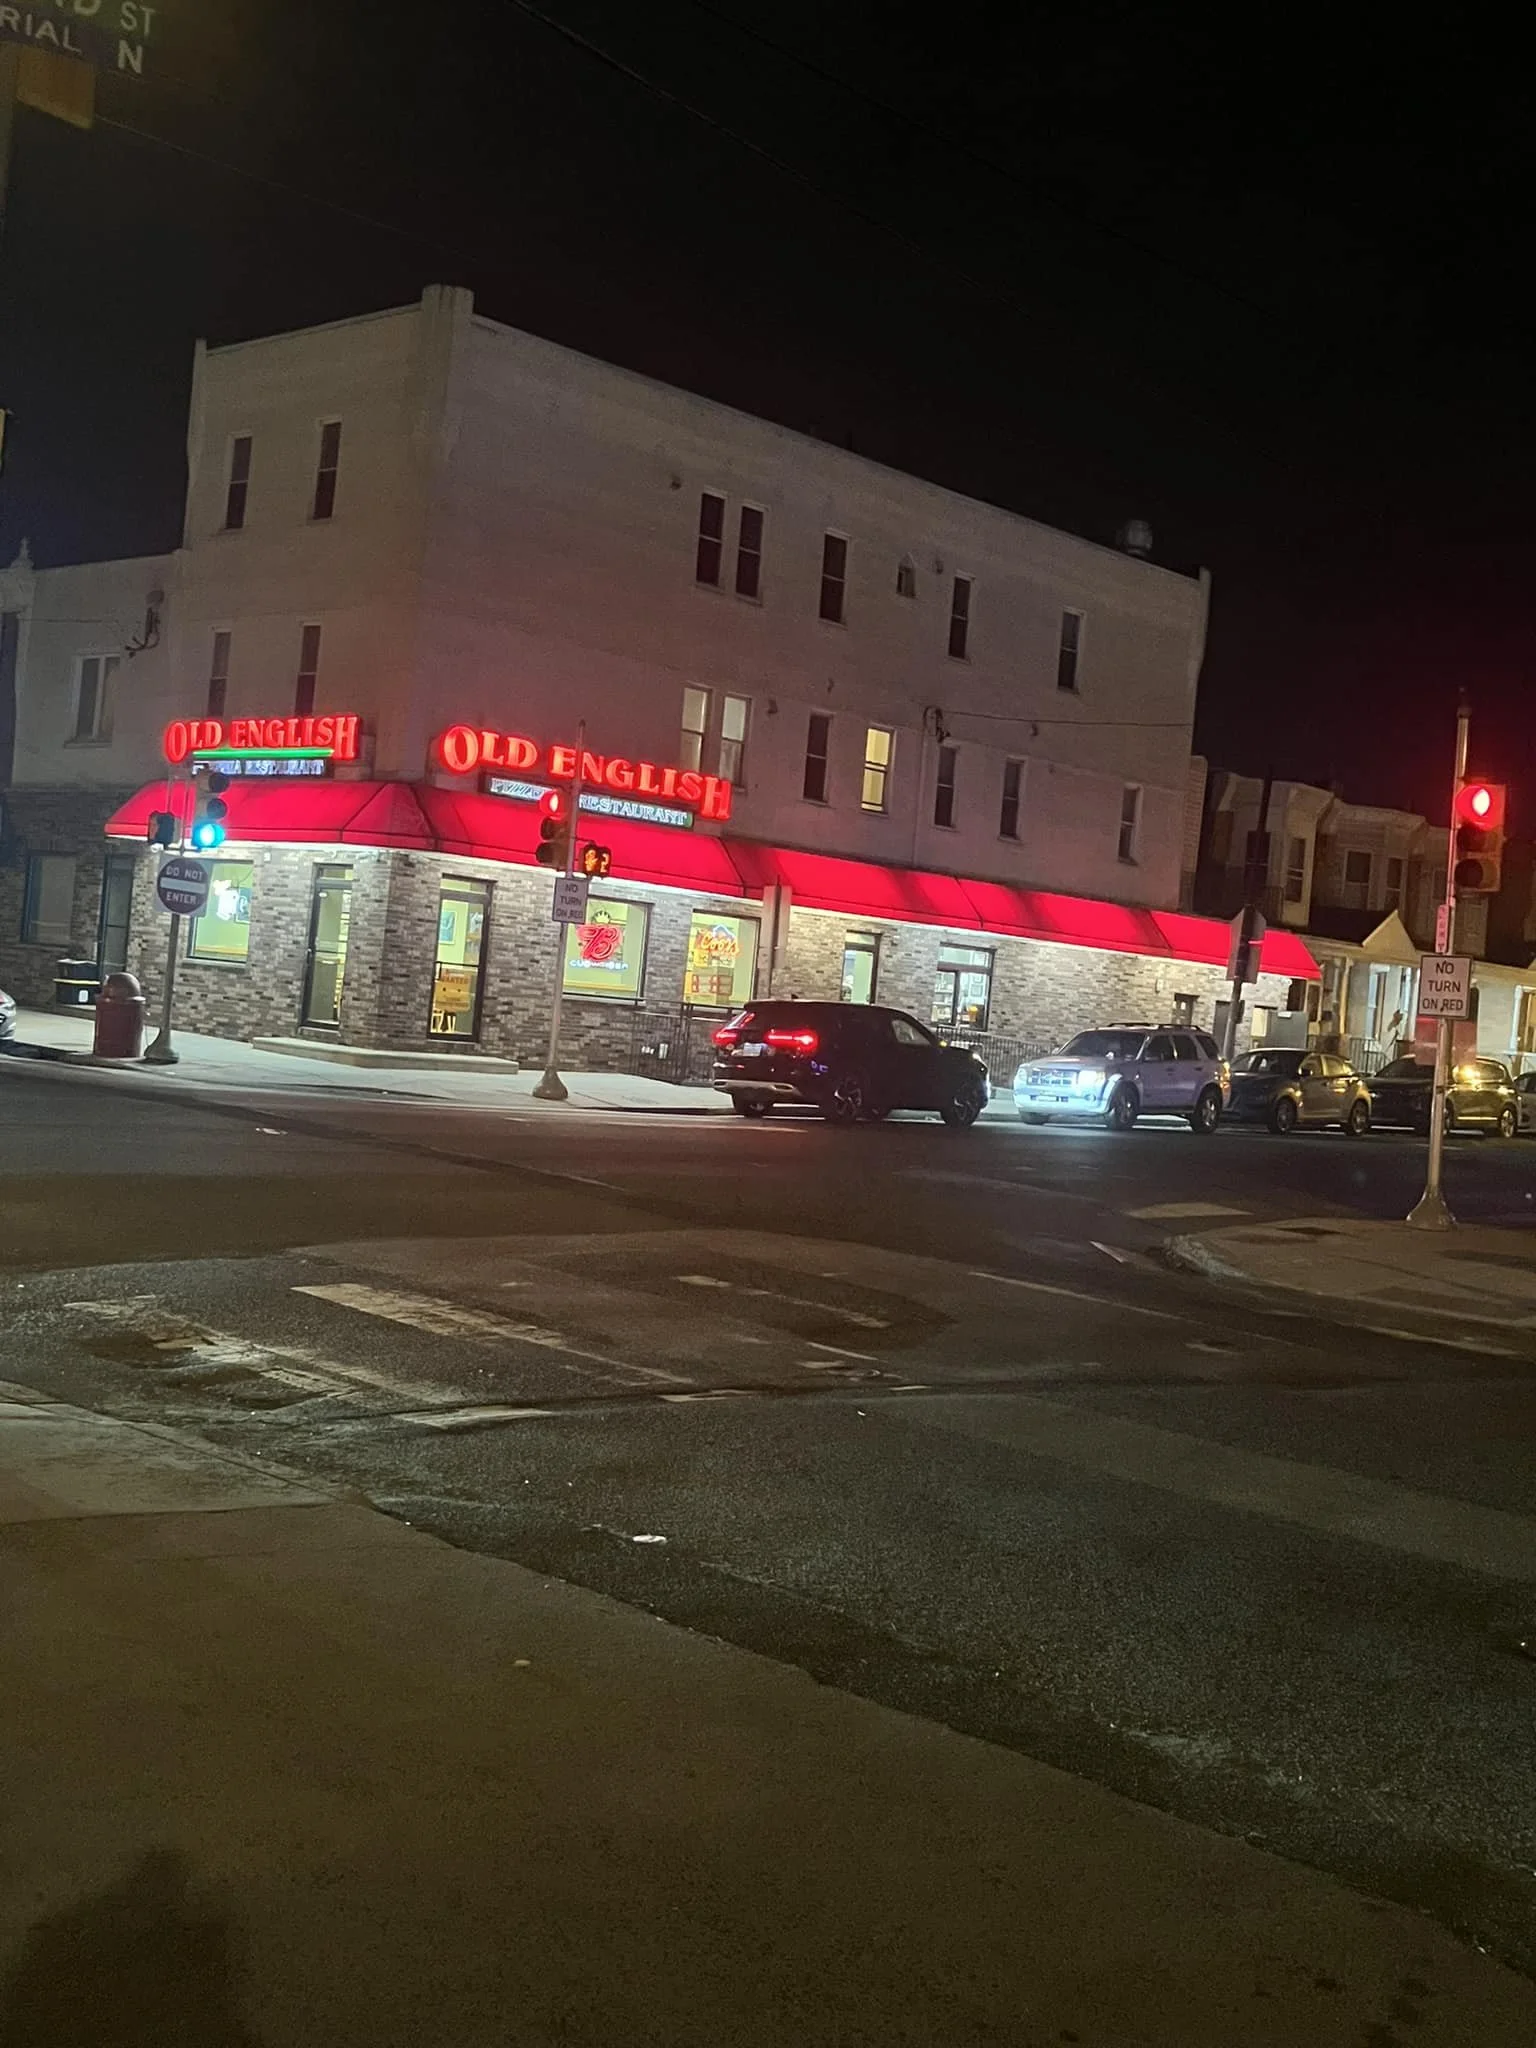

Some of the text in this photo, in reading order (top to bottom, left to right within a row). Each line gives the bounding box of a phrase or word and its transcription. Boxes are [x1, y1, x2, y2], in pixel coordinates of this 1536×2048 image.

[119, 1, 156, 37] ST
[117, 39, 143, 74] N
[166, 713, 360, 764] OLD ENGLISH
[441, 724, 733, 820] OLD ENGLISH
[578, 793, 688, 826] RESTAURANT
[166, 866, 204, 880] DO NOT
[565, 884, 578, 893] NO
[166, 891, 198, 905] ENTER
[560, 895, 582, 906] TURN
[1435, 961, 1454, 974] NO
[1428, 980, 1461, 993] TURN
[1422, 999, 1463, 1010] ON RED
